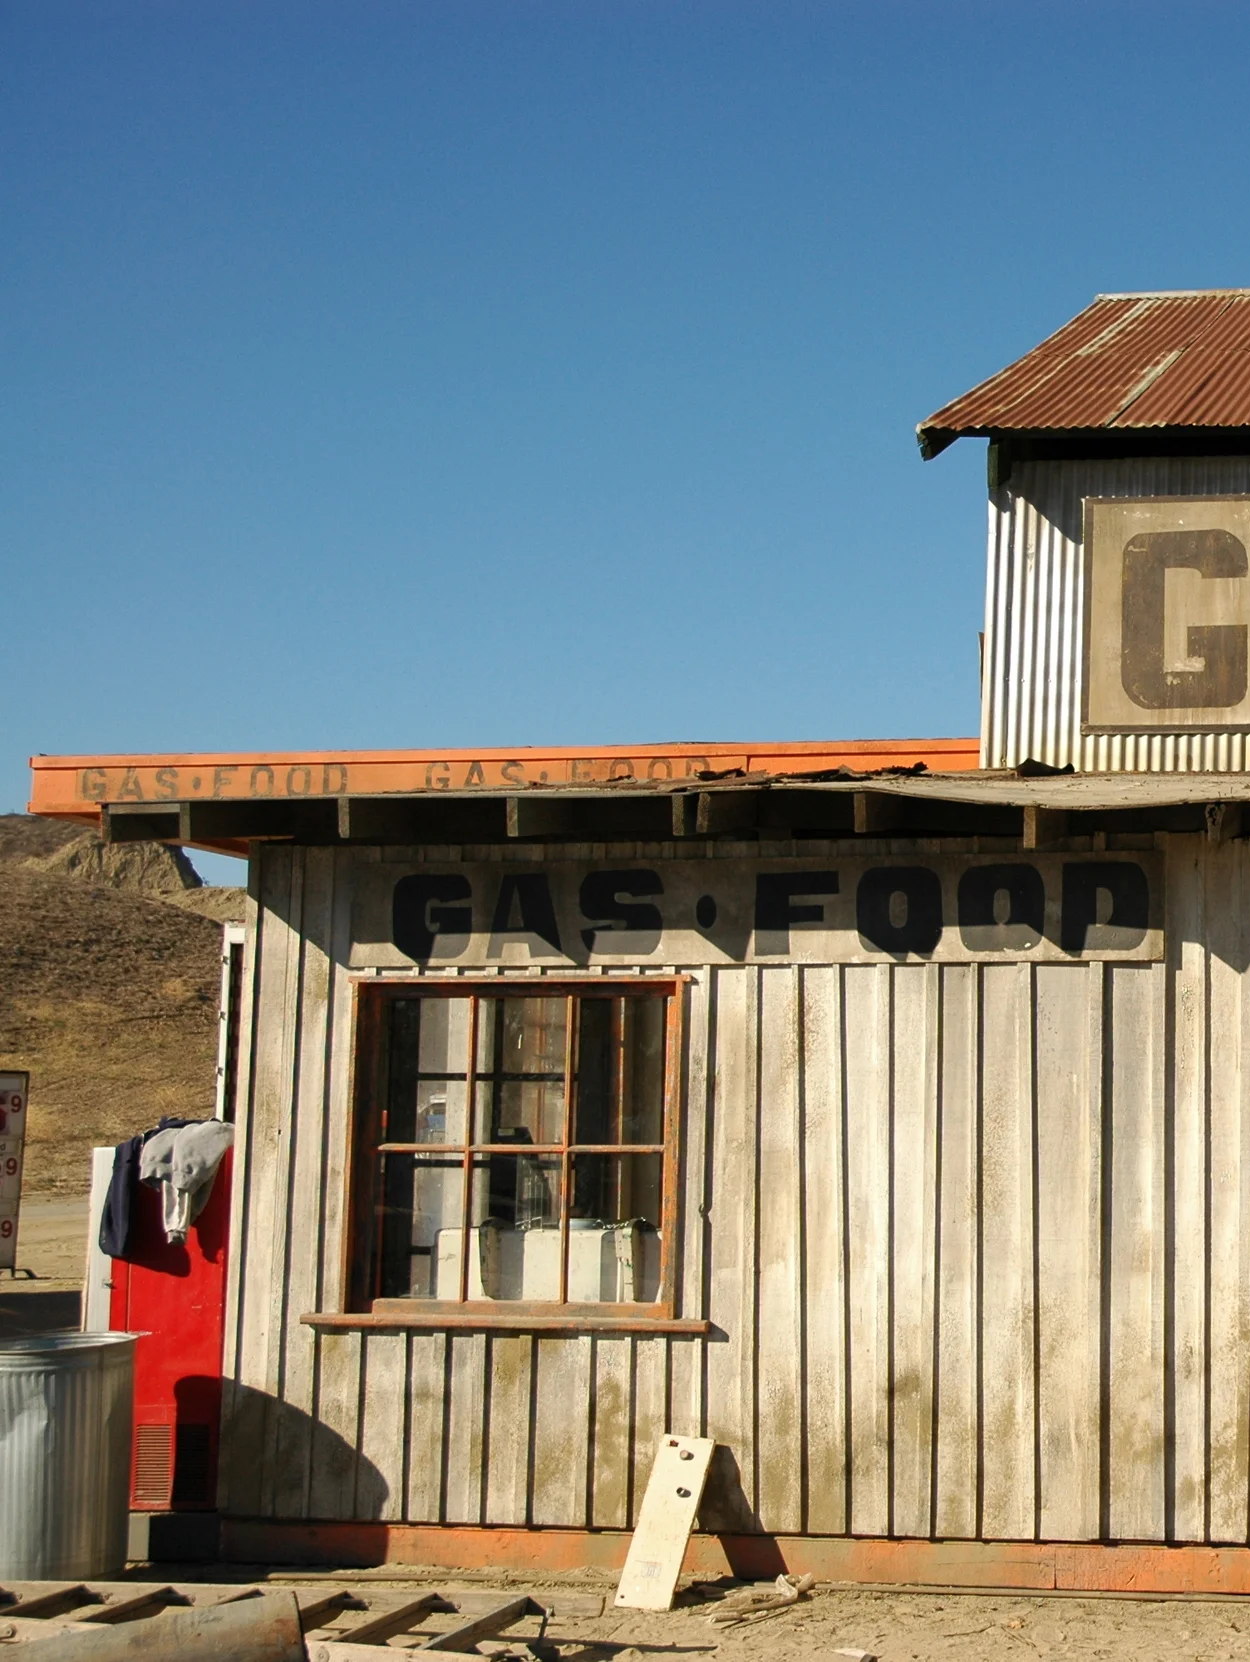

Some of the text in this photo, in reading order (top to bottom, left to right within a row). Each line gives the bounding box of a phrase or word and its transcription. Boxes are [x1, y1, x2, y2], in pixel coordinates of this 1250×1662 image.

[393, 861, 1149, 960] GAS FOOD
[10, 1095, 22, 1113] 9
[6, 1157, 17, 1176] 9
[1, 1220, 13, 1239] 9
